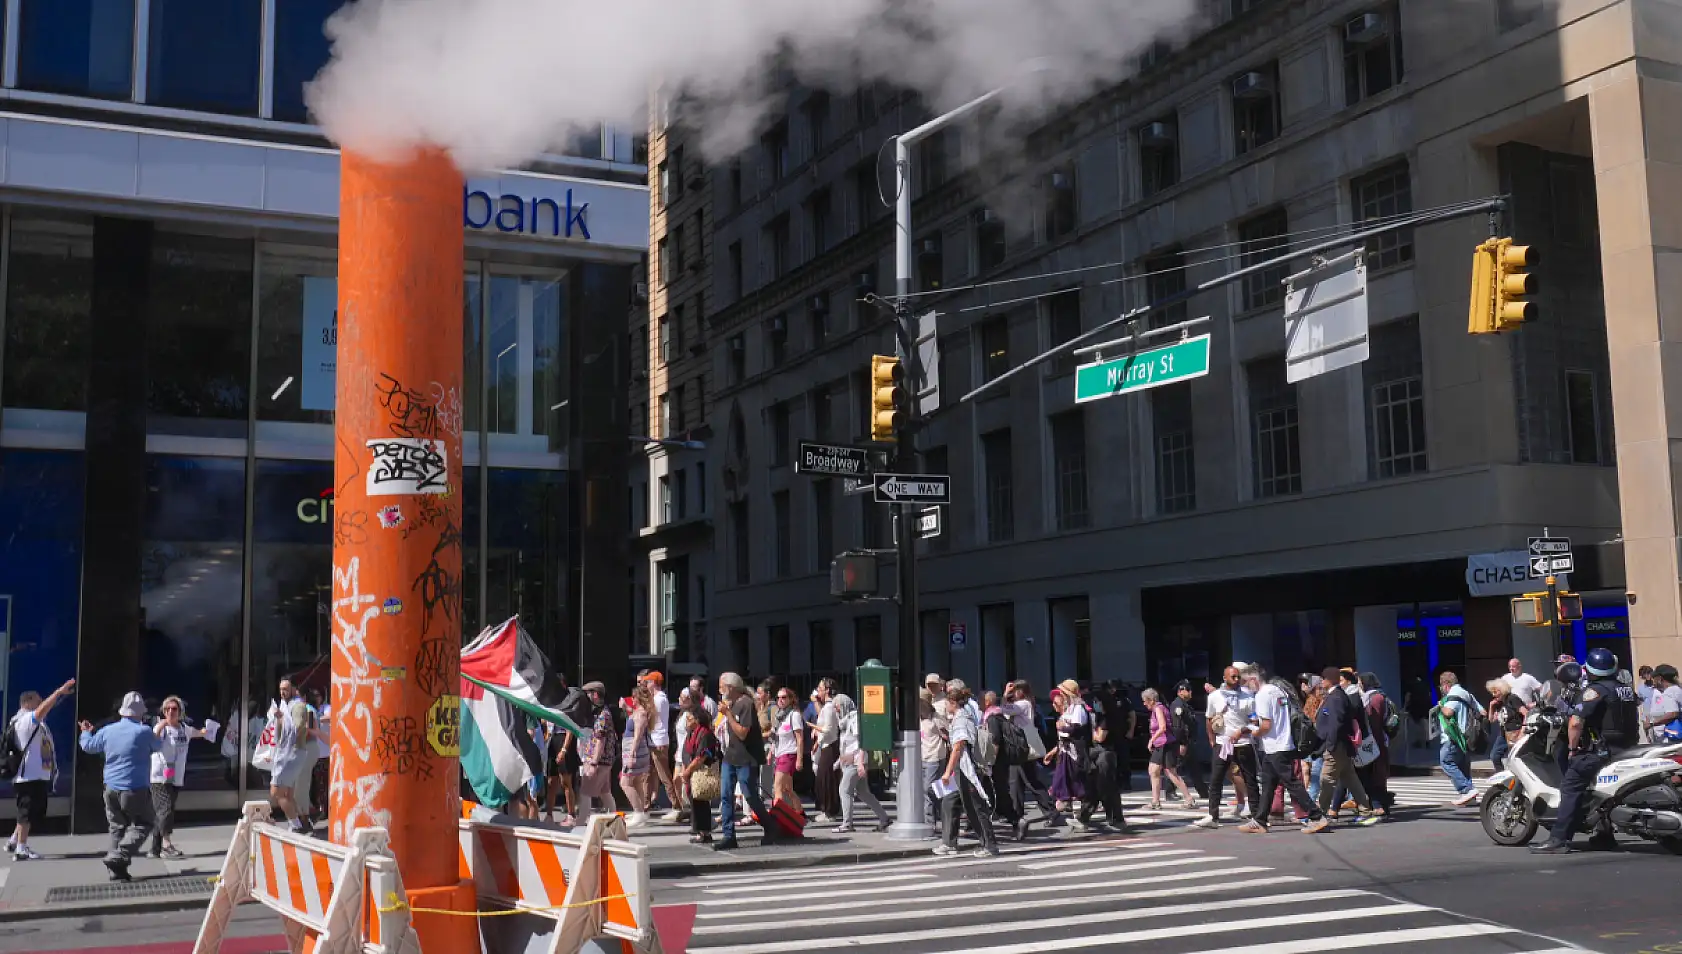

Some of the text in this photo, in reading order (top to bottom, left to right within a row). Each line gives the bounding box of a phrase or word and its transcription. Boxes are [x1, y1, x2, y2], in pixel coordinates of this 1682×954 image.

[463, 180, 591, 240] bank
[1107, 352, 1174, 387] Murray St
[806, 451, 860, 473] Broadway
[887, 483, 940, 494] ONE WAY
[1438, 629, 1462, 638] CHASE
[1587, 621, 1616, 631] CHASE
